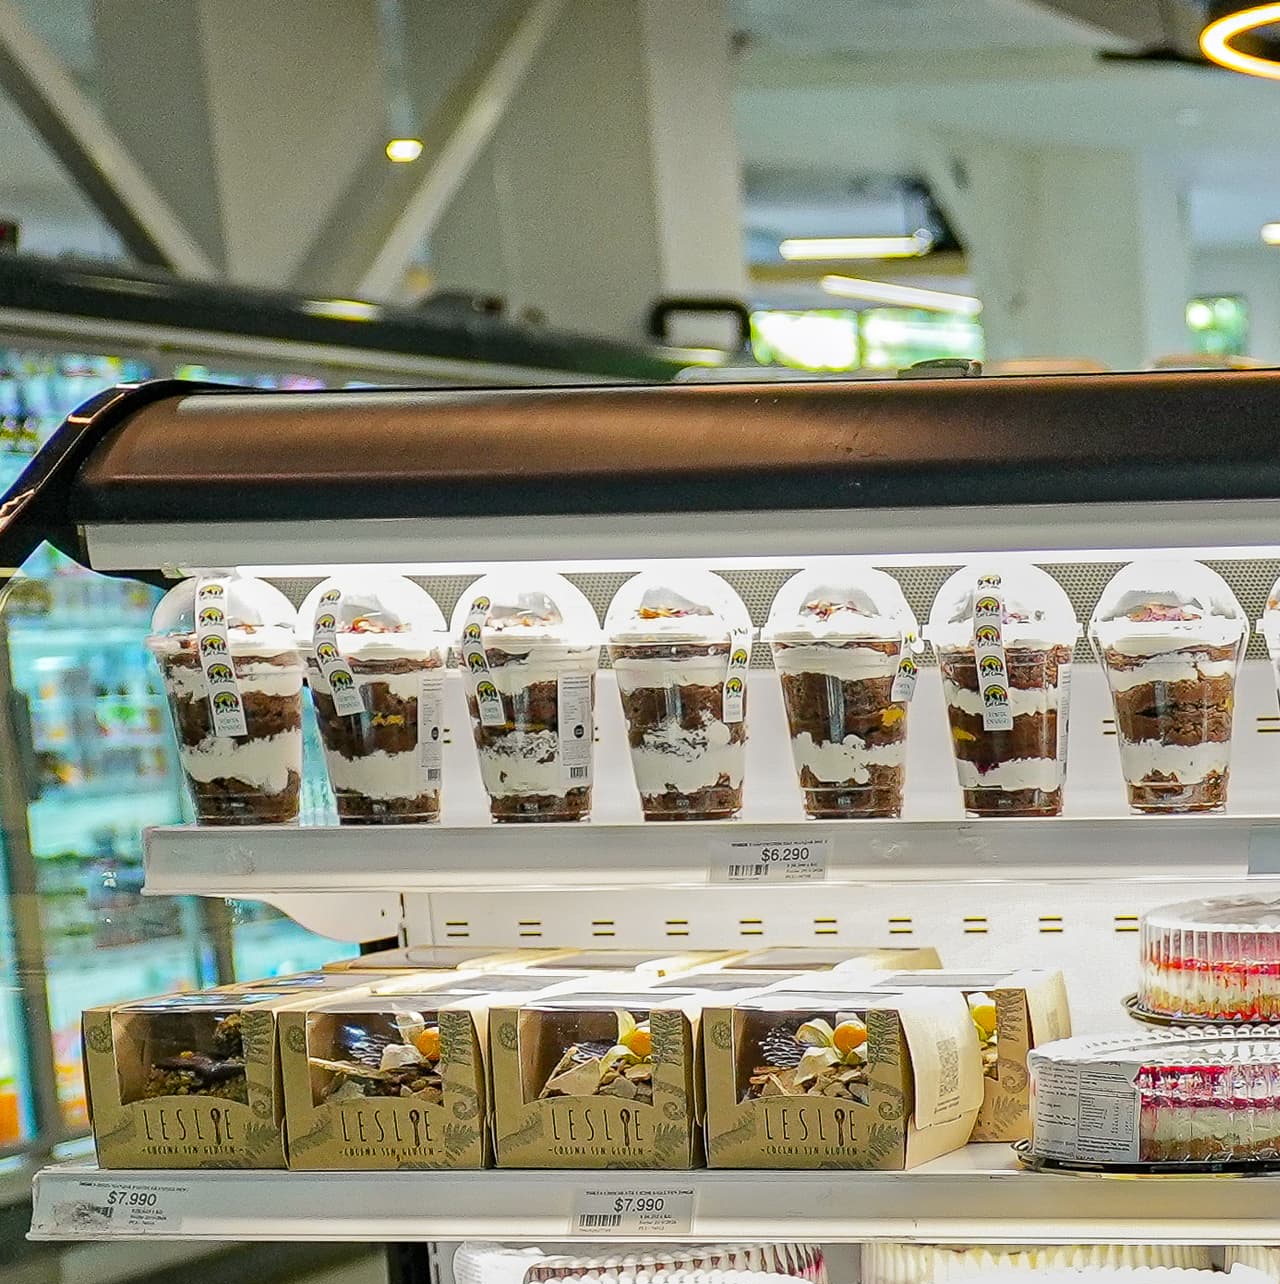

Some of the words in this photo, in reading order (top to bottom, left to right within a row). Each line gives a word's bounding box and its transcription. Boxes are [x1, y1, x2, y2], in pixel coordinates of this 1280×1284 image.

[761, 847, 809, 862] $6.290
[107, 1190, 157, 1206] $7.990
[614, 1197, 664, 1213] $7.990
